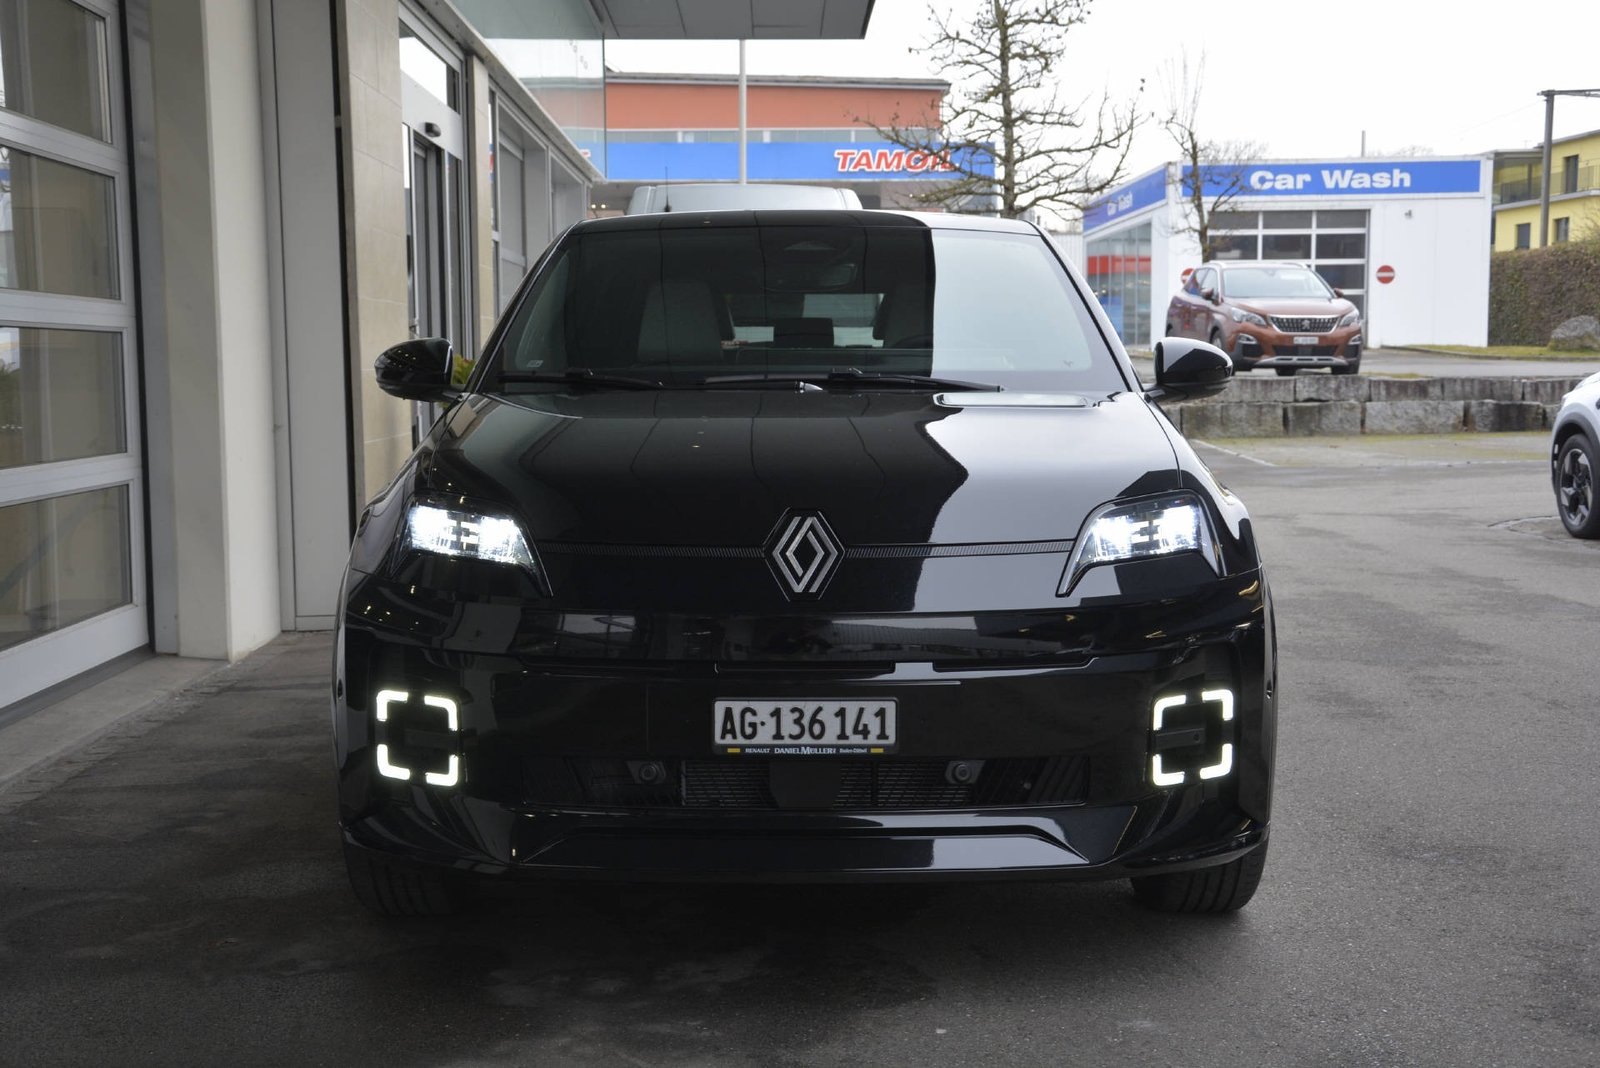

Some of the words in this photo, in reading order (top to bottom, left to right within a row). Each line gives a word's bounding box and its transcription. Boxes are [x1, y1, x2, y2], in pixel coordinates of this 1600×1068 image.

[835, 149, 958, 173] TAMOIL
[1250, 170, 1312, 190] Car
[1321, 168, 1411, 189] Wash
